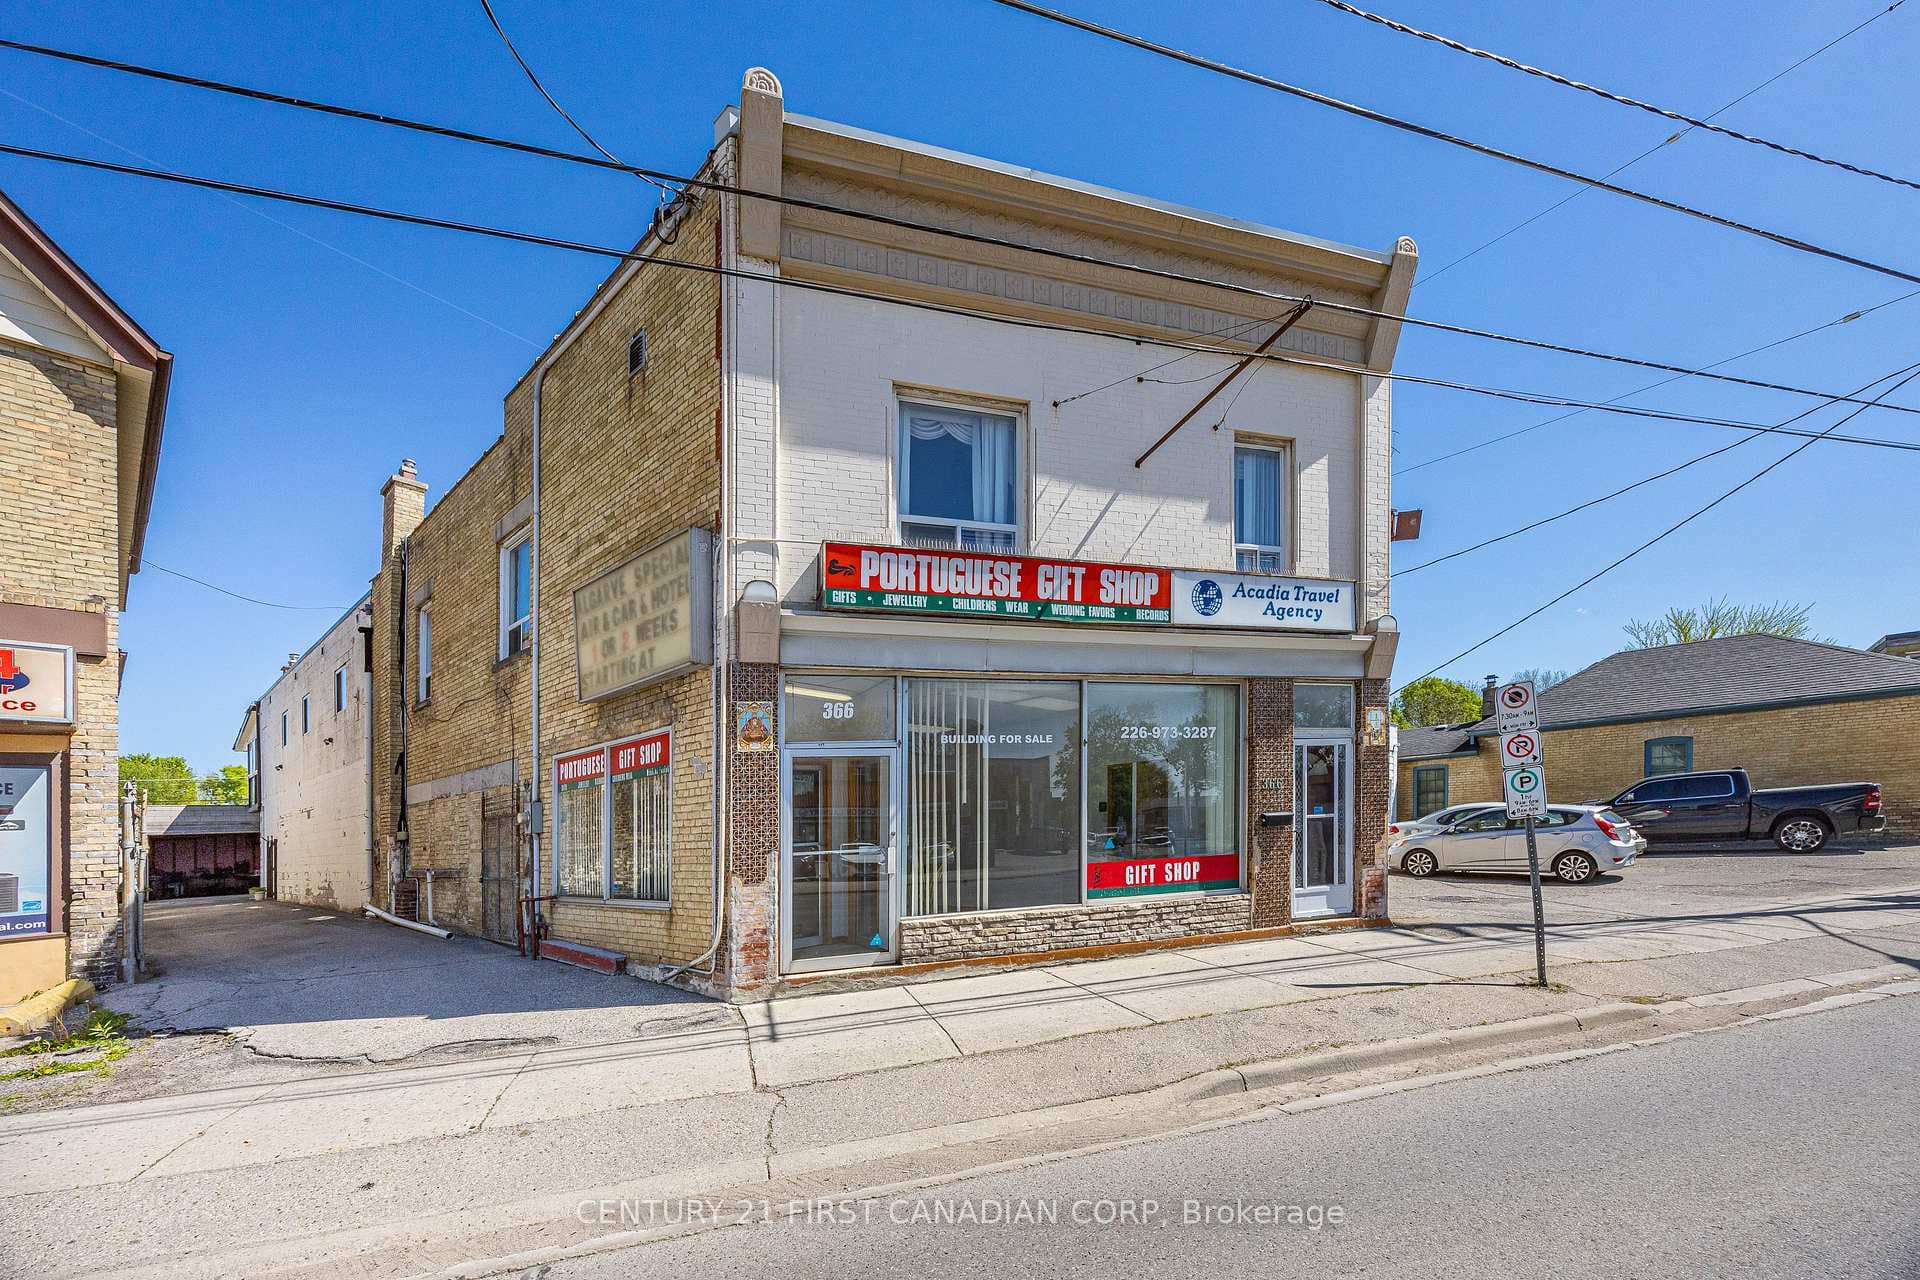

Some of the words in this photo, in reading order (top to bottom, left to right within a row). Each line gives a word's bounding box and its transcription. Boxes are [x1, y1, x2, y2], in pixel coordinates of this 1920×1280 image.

[860, 550, 1022, 598] PORTUGUESE
[1037, 564, 1086, 601] GIFT
[1100, 567, 1159, 606] SHOP
[1232, 582, 1289, 601] Acadia
[1293, 585, 1340, 604] Travel
[832, 590, 857, 604] GIFTS
[882, 593, 928, 608] JEWELLERY
[952, 597, 997, 612] CHILDRENS
[1005, 601, 1029, 614] WEAR
[1051, 603, 1085, 617] WEDDING
[1088, 606, 1115, 619] FAVORS
[1136, 609, 1169, 621] RECORDS
[1262, 601, 1323, 622] Agency
[822, 702, 855, 719] 366
[940, 734, 996, 744] BUILDING
[1000, 734, 1022, 744] FOR
[1025, 734, 1053, 744] SALE
[1120, 726, 1217, 739] 226-973-3287
[560, 754, 604, 780] PORTUGUESE
[619, 747, 636, 769] GIFT
[640, 741, 662, 765] SHOP
[1125, 864, 1156, 885] GIFT
[1165, 861, 1200, 882] SHOP
